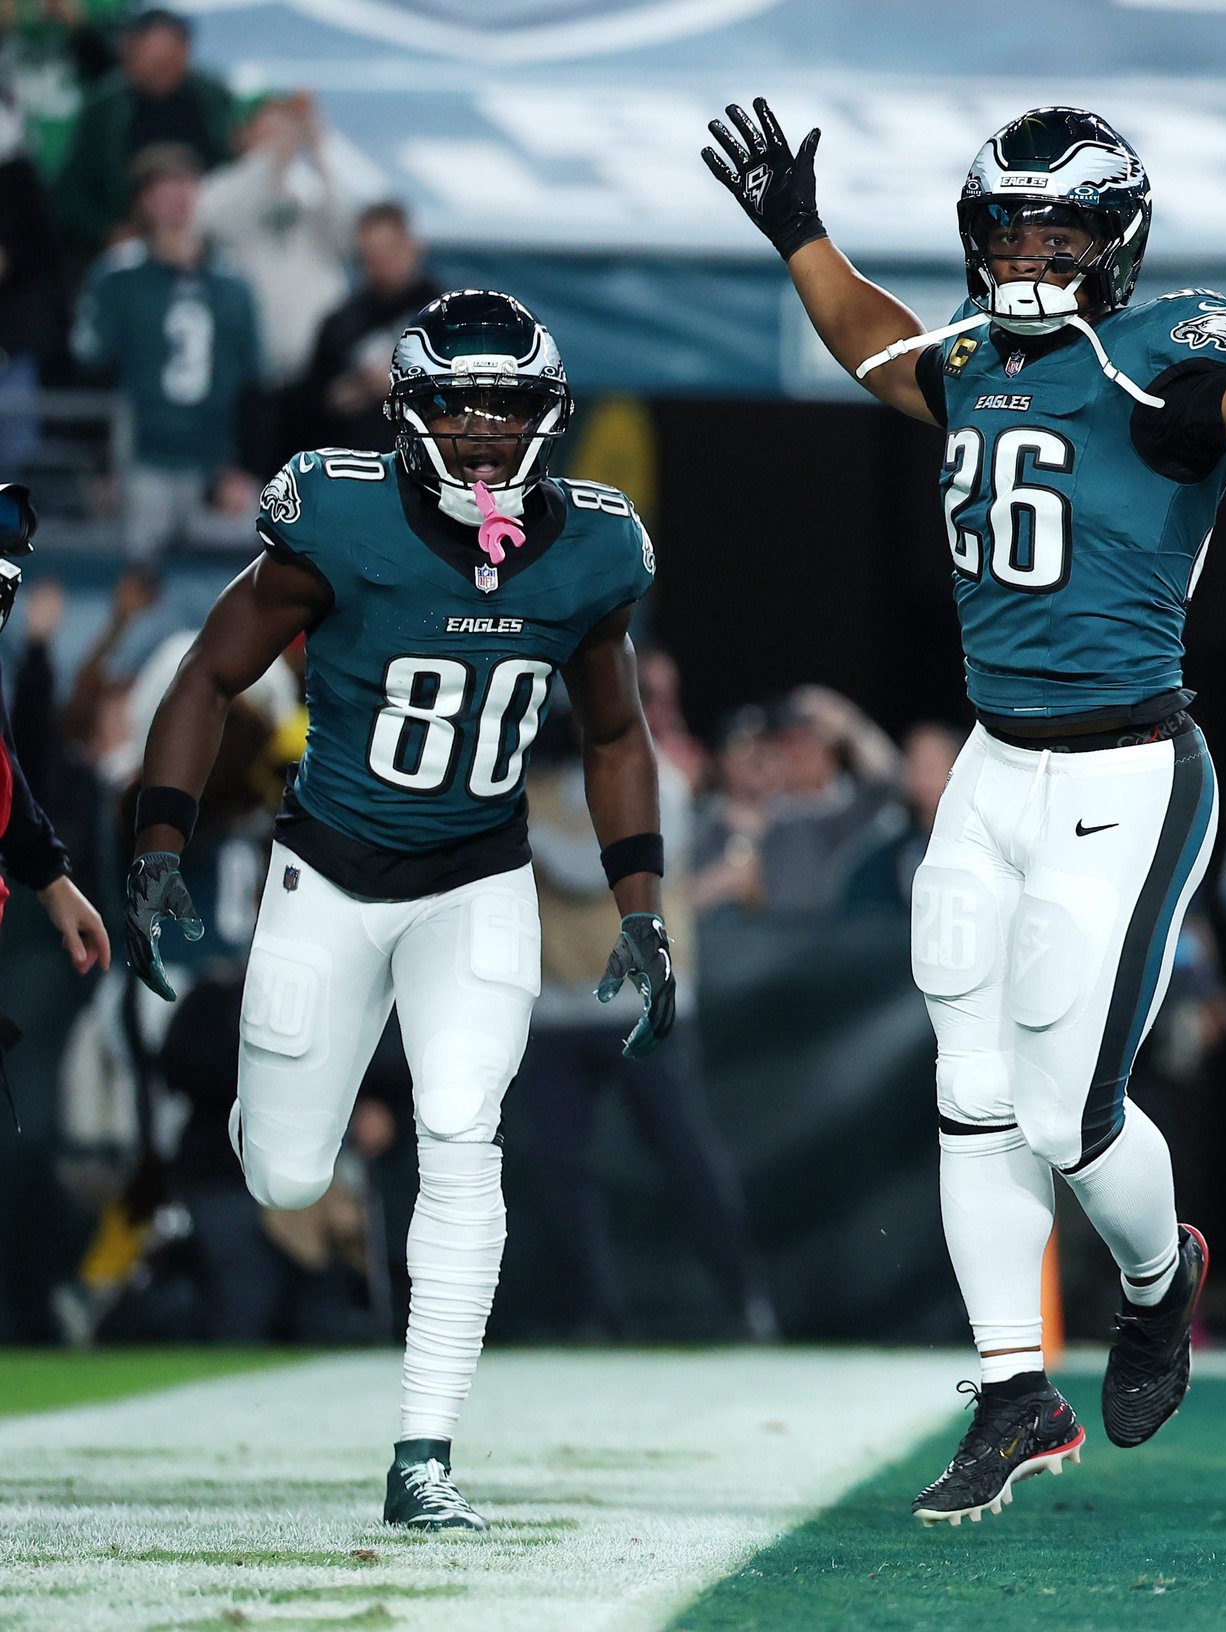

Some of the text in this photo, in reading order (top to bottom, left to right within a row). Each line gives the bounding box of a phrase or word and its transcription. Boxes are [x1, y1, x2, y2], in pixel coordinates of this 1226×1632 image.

[1001, 177, 1048, 188] EAGLES
[164, 302, 214, 405] 3
[949, 338, 978, 367] C
[975, 395, 1031, 411] EAGLES
[944, 427, 1070, 590] 26
[446, 618, 524, 633] EAGLES
[369, 657, 554, 797] 80
